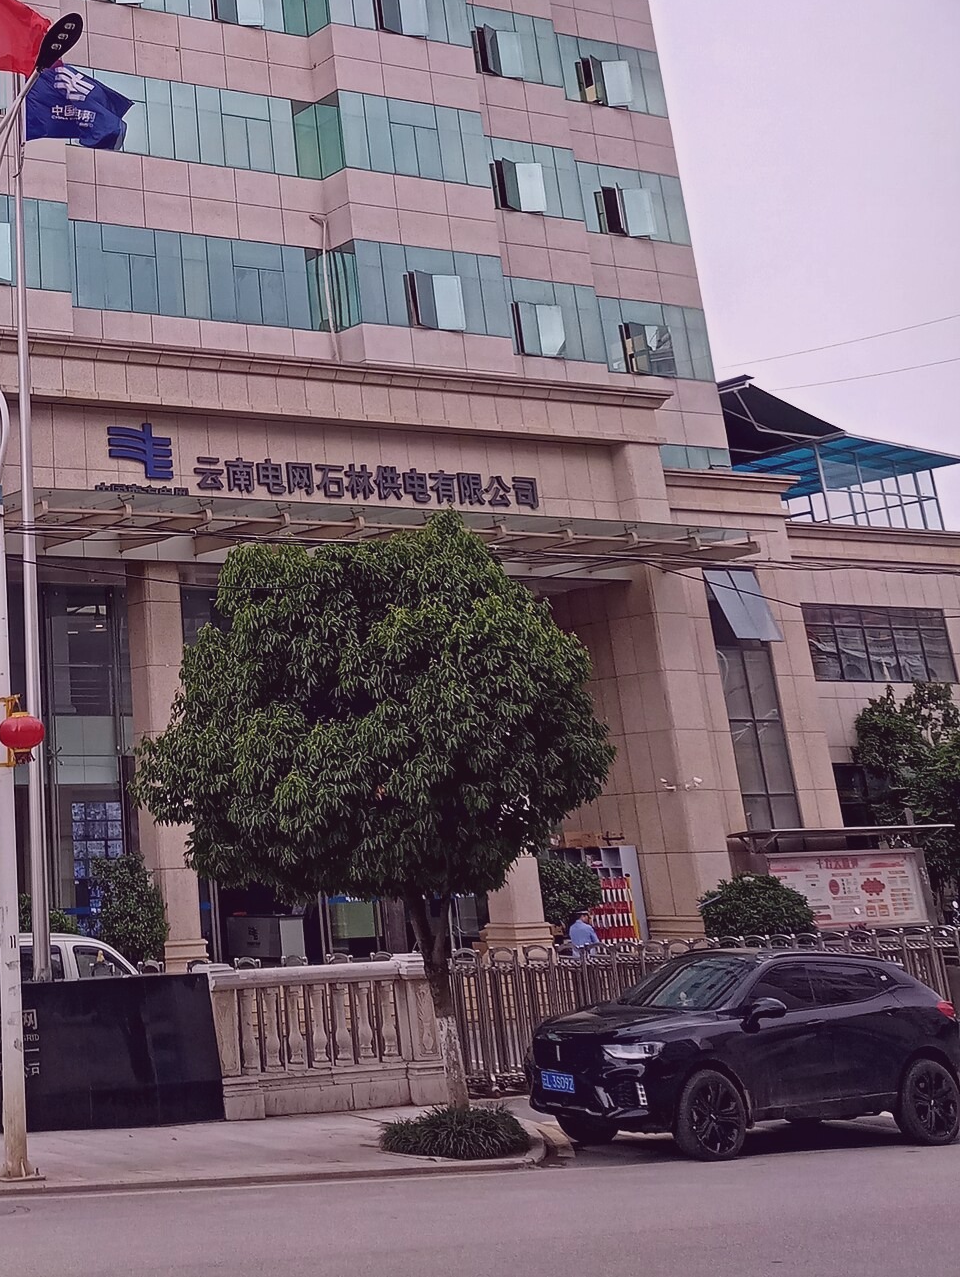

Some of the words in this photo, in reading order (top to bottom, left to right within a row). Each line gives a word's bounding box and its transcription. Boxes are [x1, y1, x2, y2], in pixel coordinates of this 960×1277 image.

[194, 456, 539, 509] 云南电网石林供电有限公司
